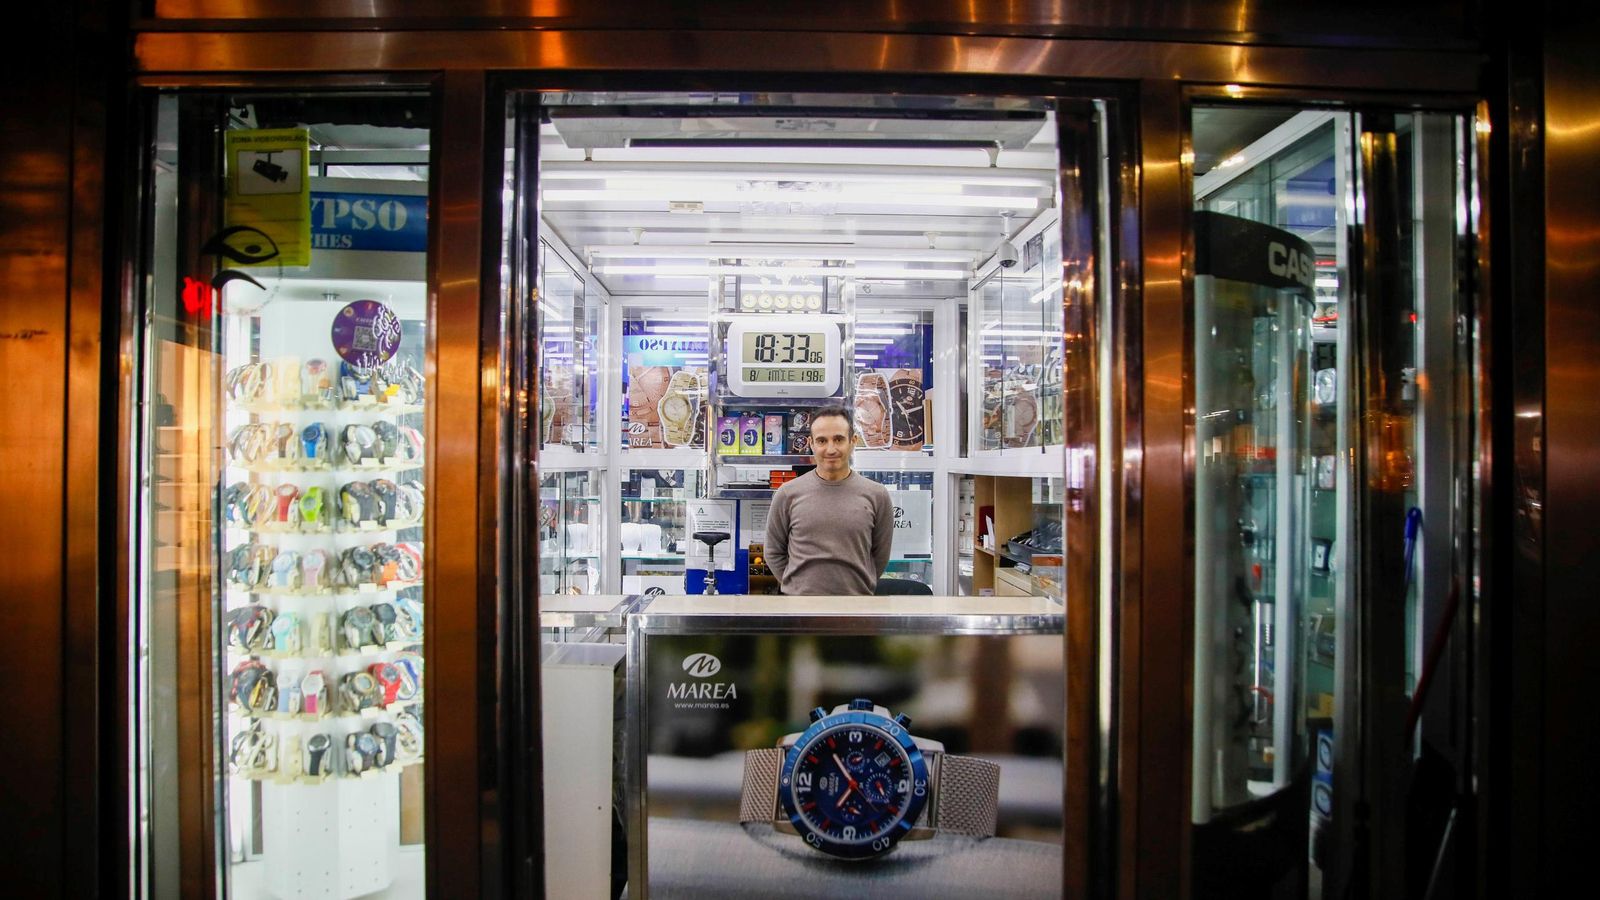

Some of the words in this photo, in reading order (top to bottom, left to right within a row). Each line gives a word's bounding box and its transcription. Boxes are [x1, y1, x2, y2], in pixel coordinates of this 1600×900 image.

[311, 233, 353, 248] HES
[1268, 241, 1313, 287] CAS
[755, 334, 810, 363] 18:33
[810, 351, 823, 363] 06
[666, 682, 737, 700] MAREA
[674, 702, 730, 710] www.marea.es
[798, 772, 812, 793] 12
